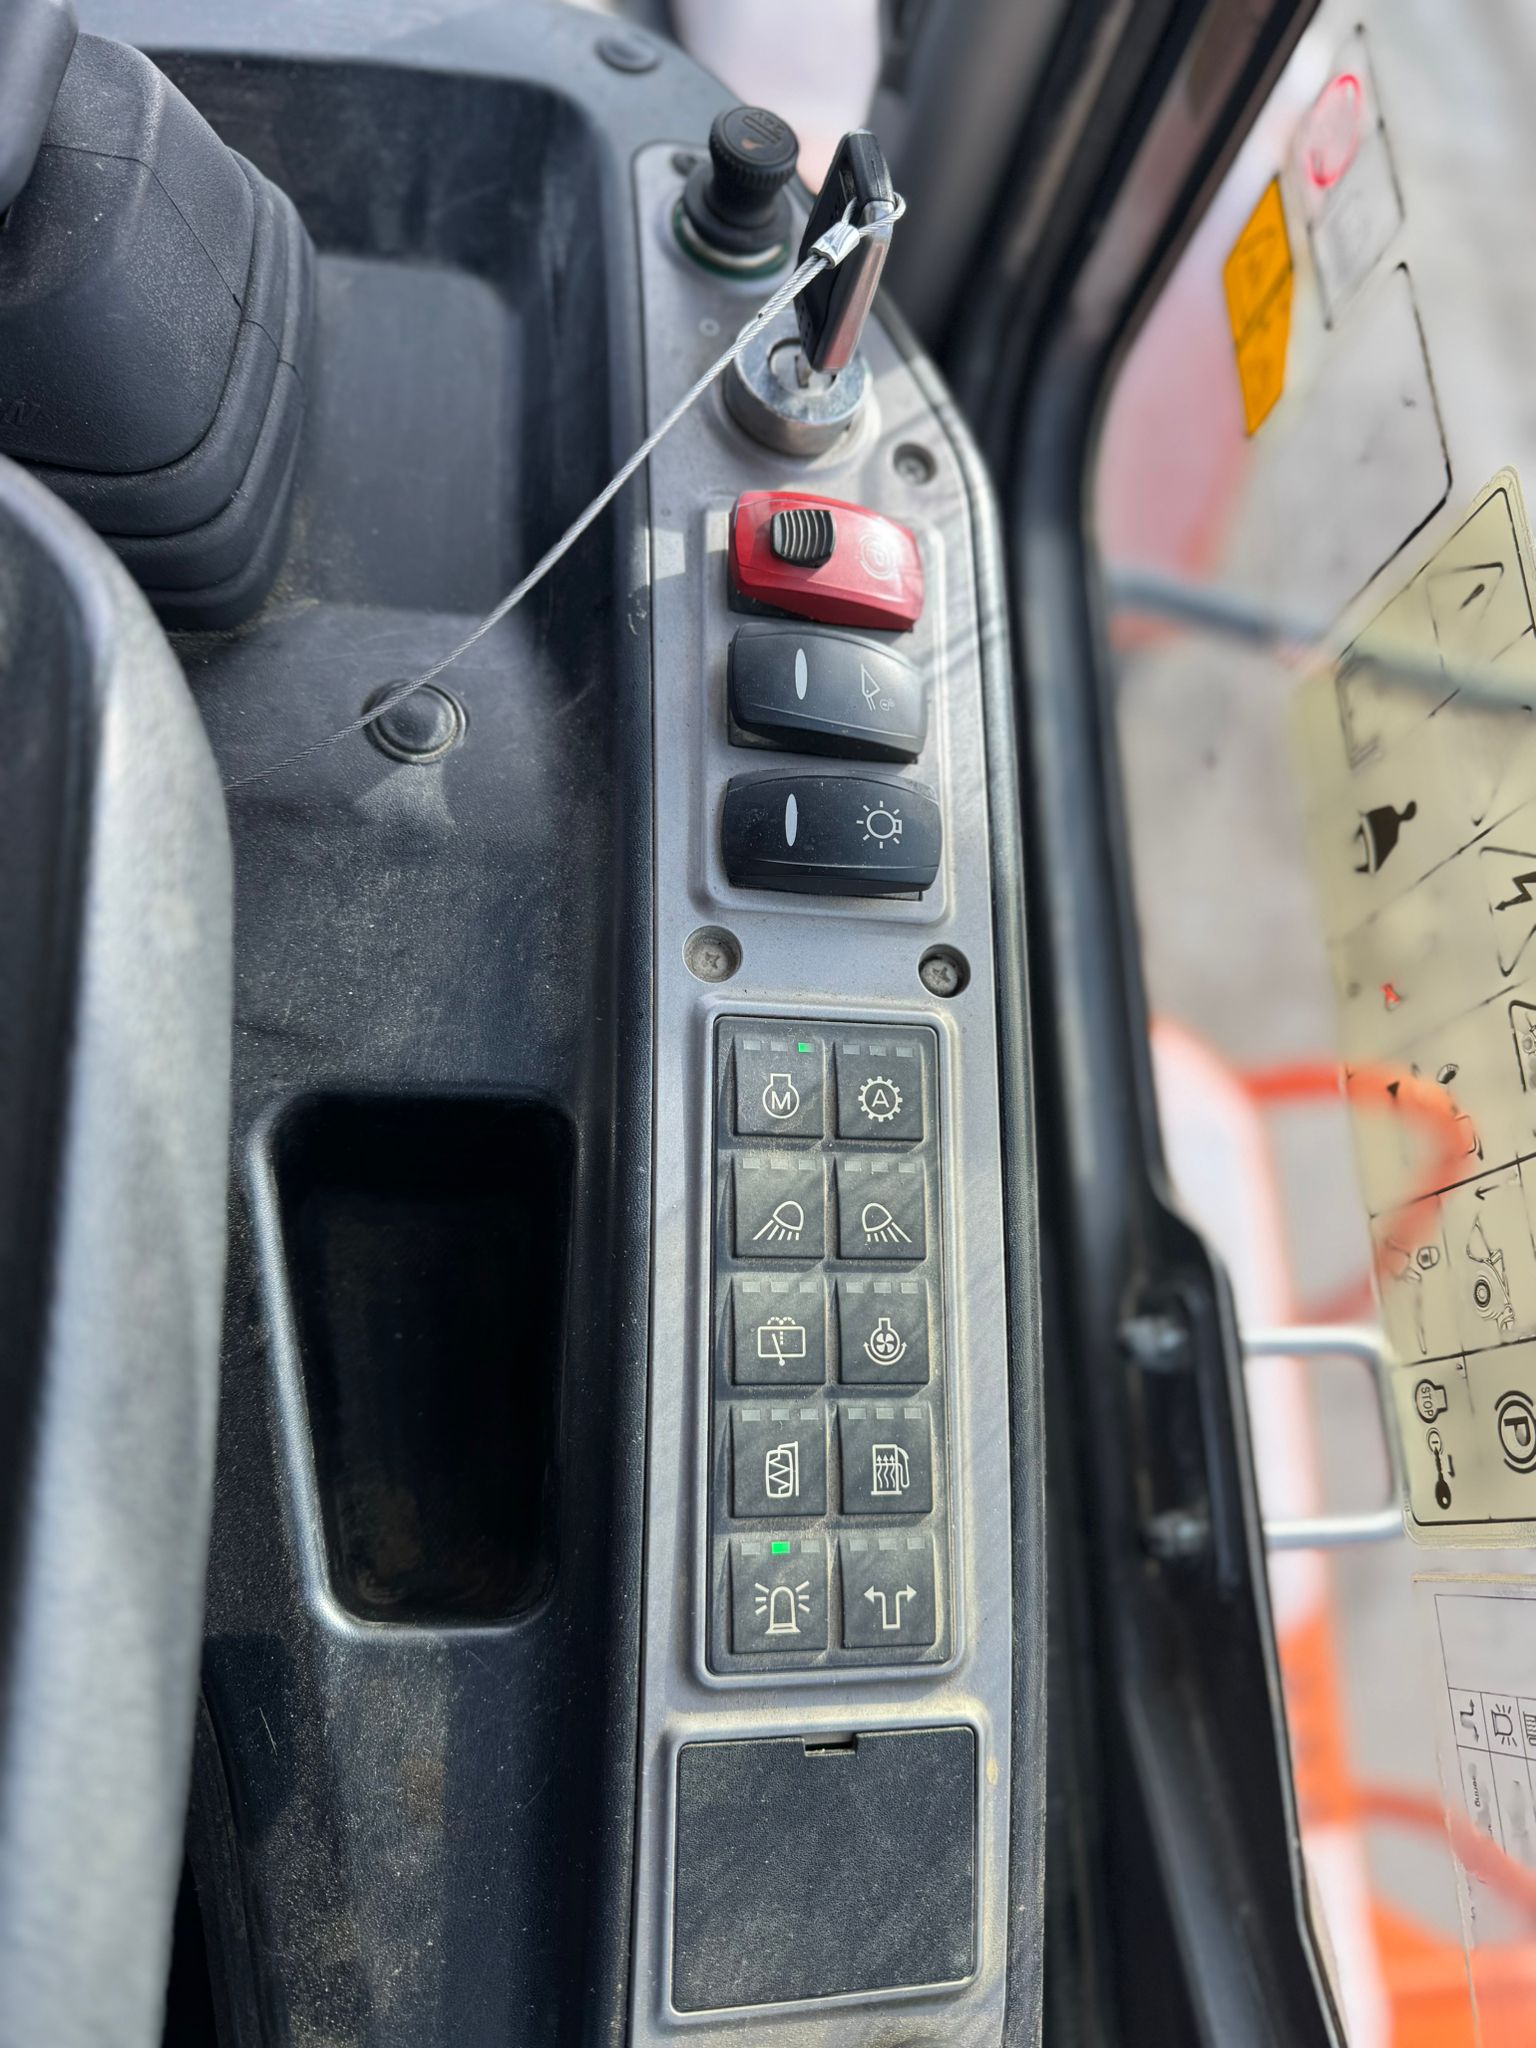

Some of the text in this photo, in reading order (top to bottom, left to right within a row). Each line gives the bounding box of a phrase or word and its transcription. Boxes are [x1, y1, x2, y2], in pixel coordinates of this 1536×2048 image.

[772, 1091, 791, 1110] M
[872, 1089, 890, 1108] A
[1421, 1386, 1435, 1417] STOP
[1504, 1416, 1531, 1446] P
